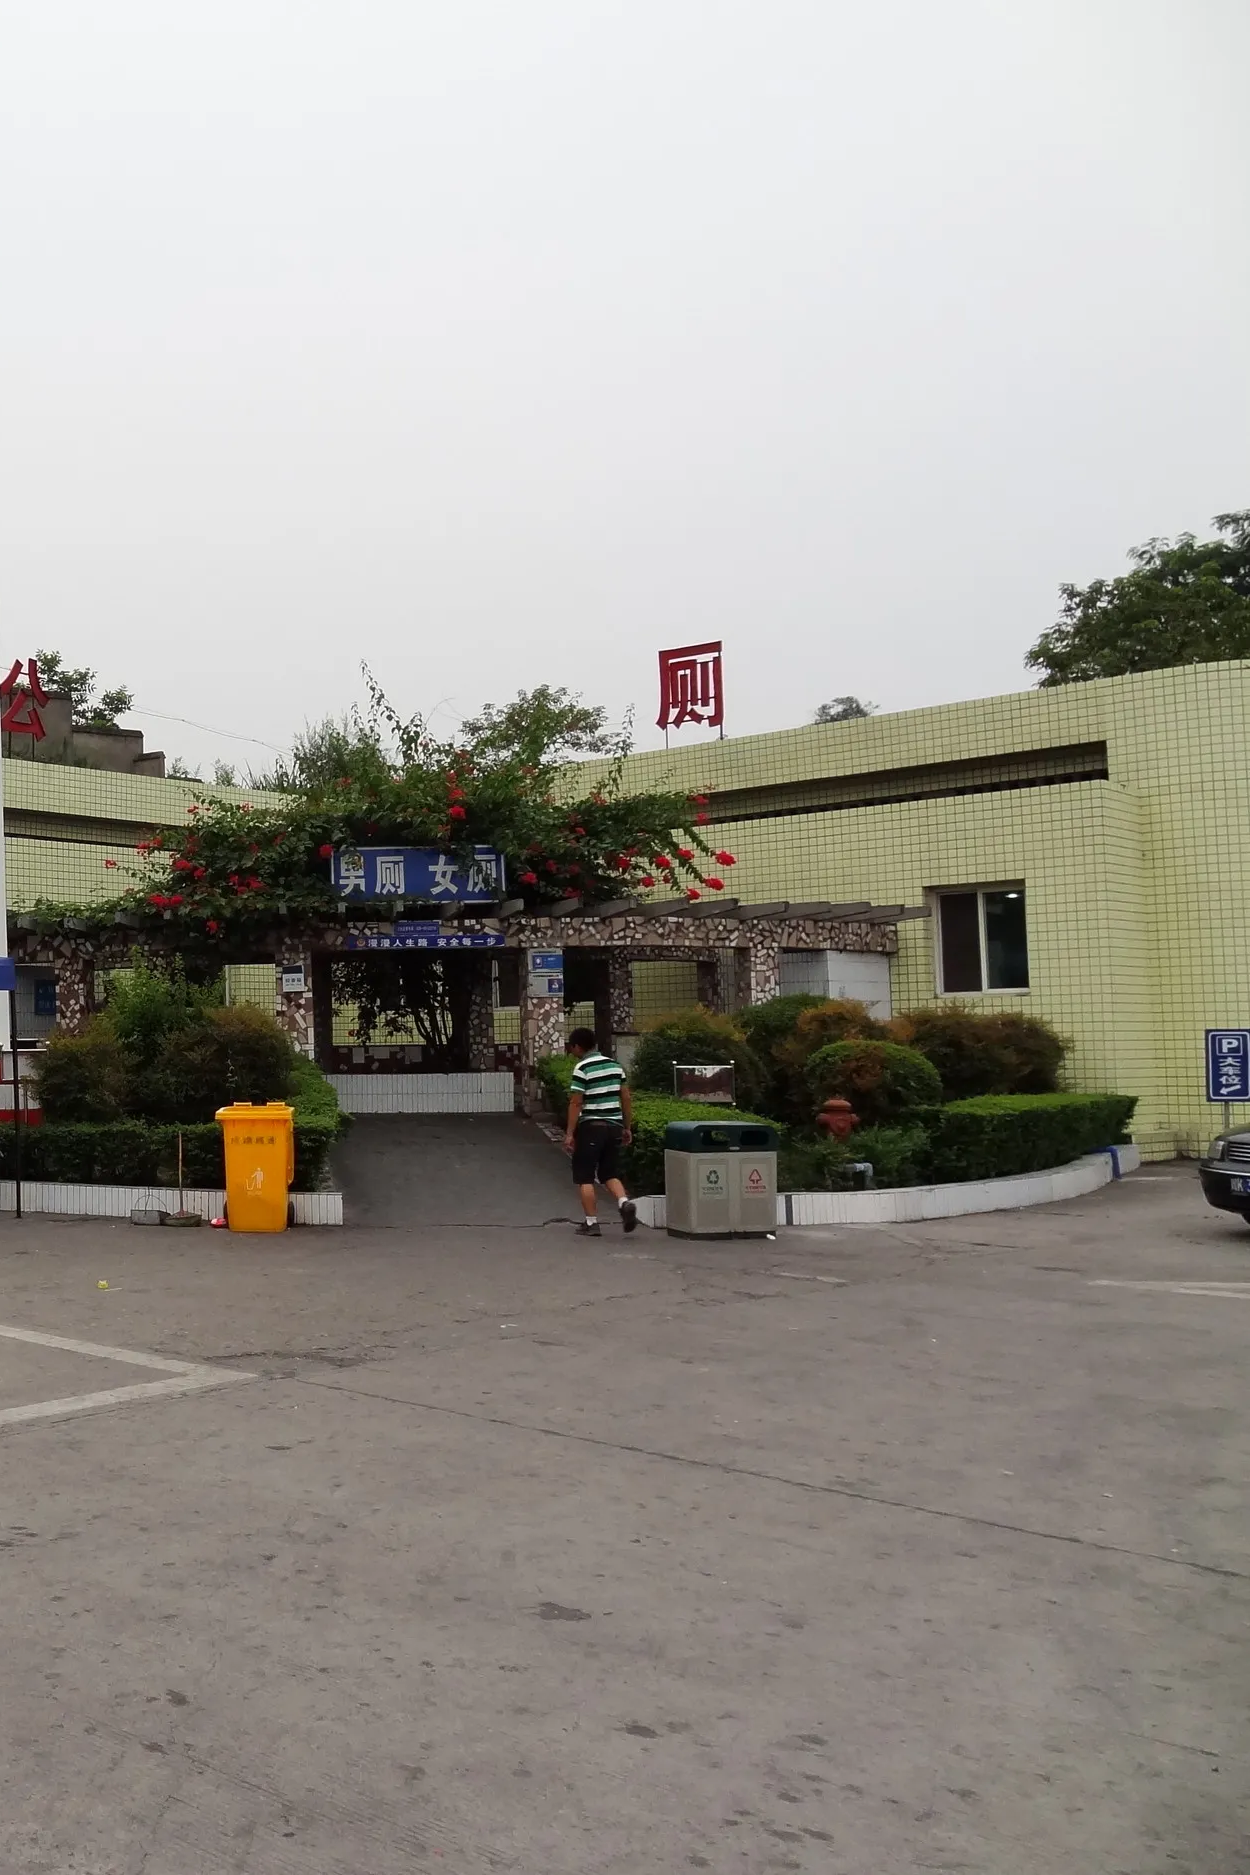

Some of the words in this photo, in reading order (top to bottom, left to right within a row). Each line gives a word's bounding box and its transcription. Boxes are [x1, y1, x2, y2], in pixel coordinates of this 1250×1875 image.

[0, 657, 50, 743] 公
[655, 640, 724, 731] 厕
[339, 854, 406, 896] 男厕
[1222, 1038, 1239, 1053] P
[1218, 1056, 1242, 1085] 大车位
